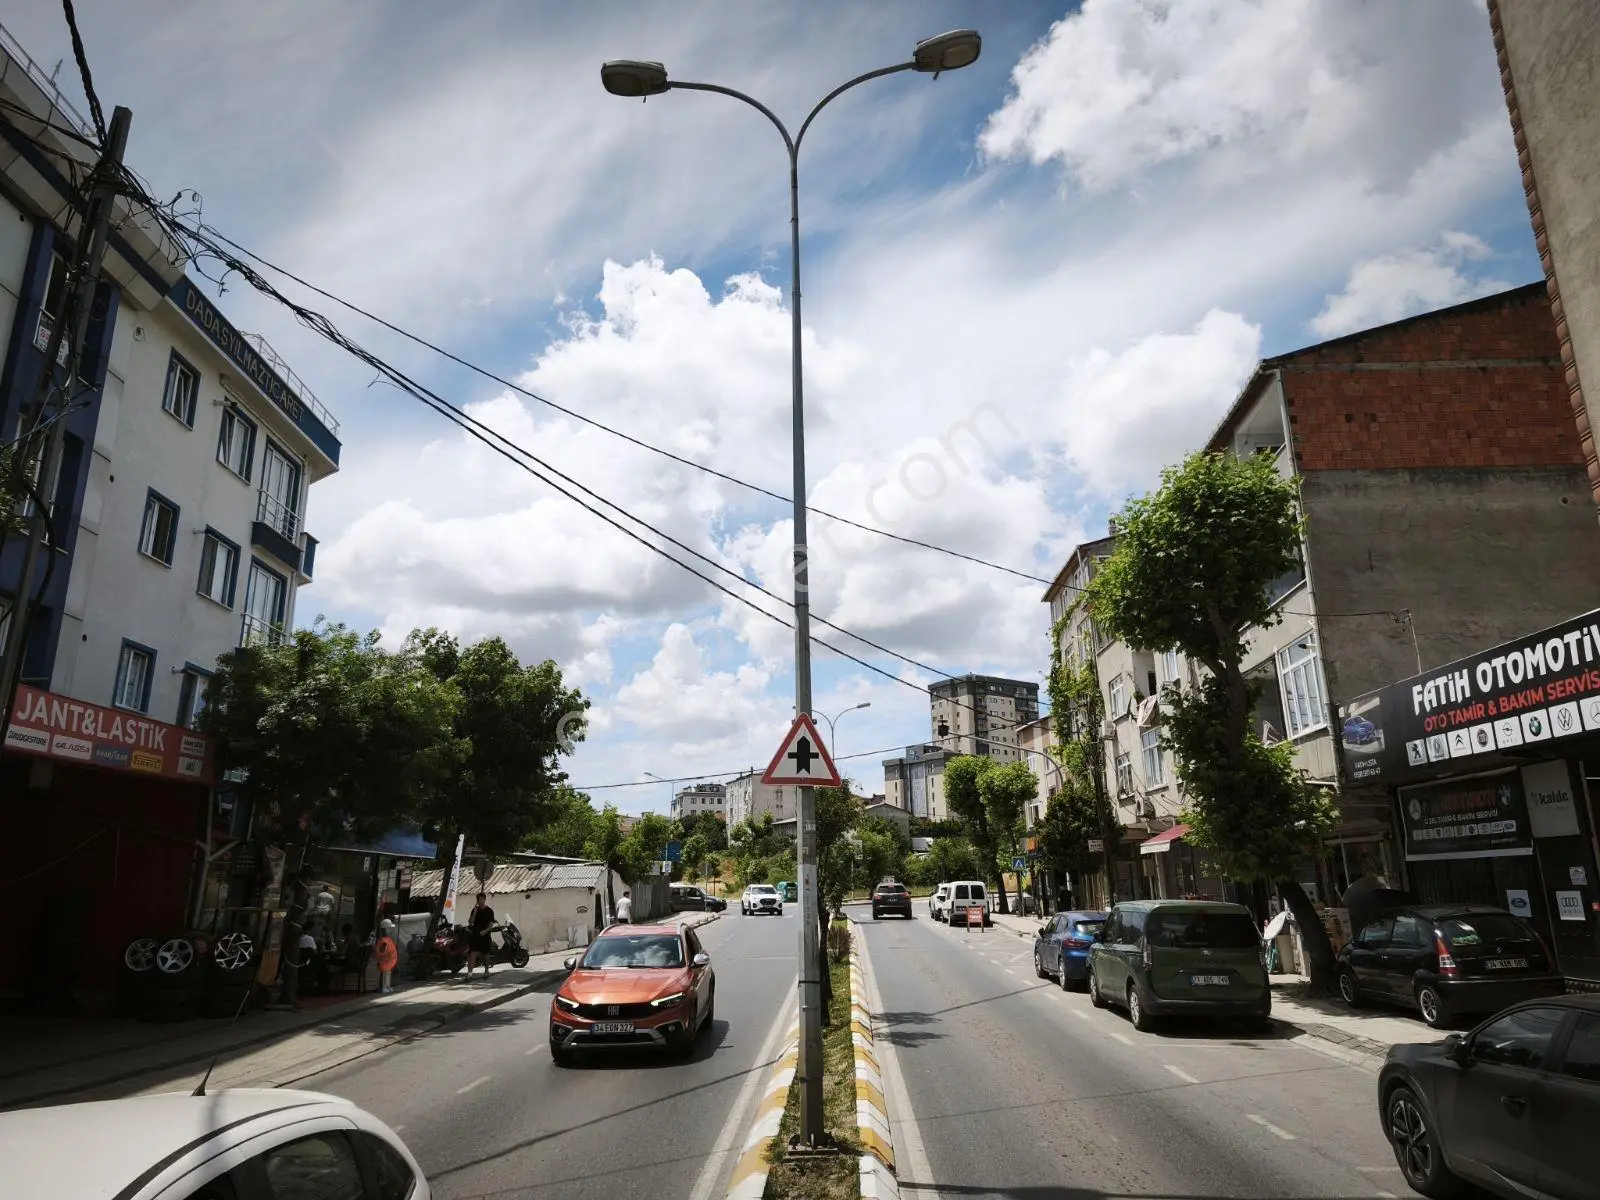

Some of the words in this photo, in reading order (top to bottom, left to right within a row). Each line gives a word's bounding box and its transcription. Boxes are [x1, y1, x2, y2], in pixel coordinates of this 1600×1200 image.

[1424, 713, 1447, 733] OTO
[1448, 701, 1485, 725] TAMİR
[1488, 700, 1497, 716] &
[1499, 686, 1544, 713] BAKIM
